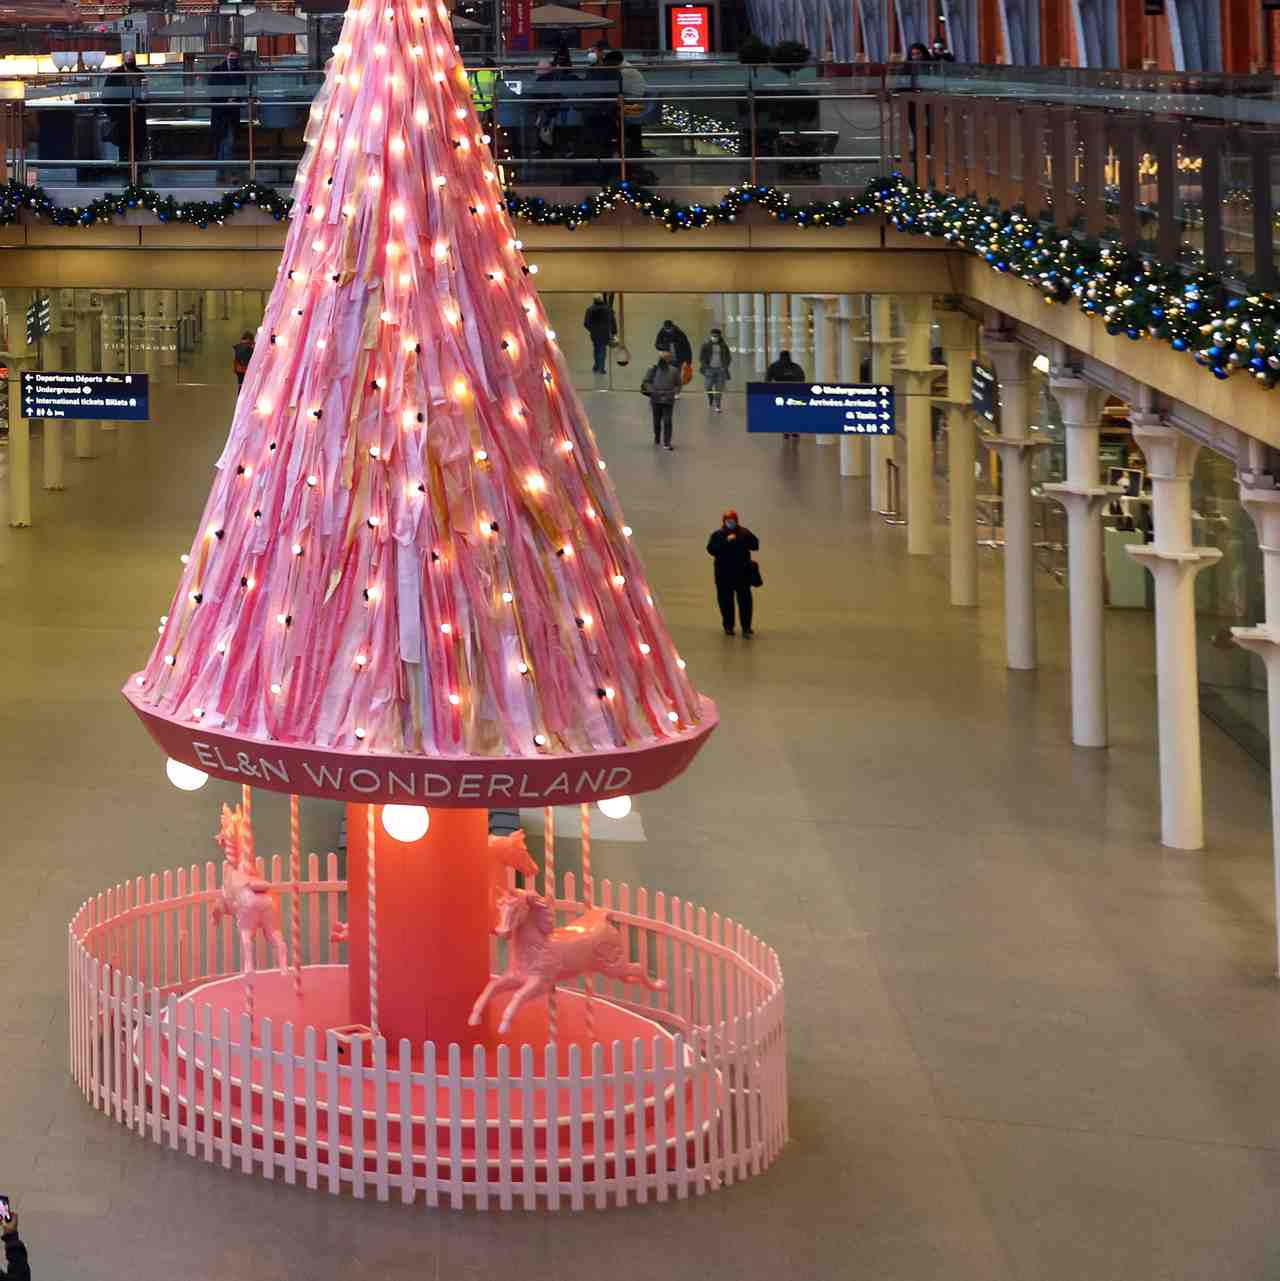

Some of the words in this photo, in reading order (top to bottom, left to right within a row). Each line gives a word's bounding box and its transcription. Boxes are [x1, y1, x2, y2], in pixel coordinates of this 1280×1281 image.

[35, 374, 74, 383] Departures
[35, 385, 81, 394] Underground
[35, 397, 80, 405] International
[192, 741, 289, 783] EL&N
[303, 761, 632, 799] WONDERLAND
